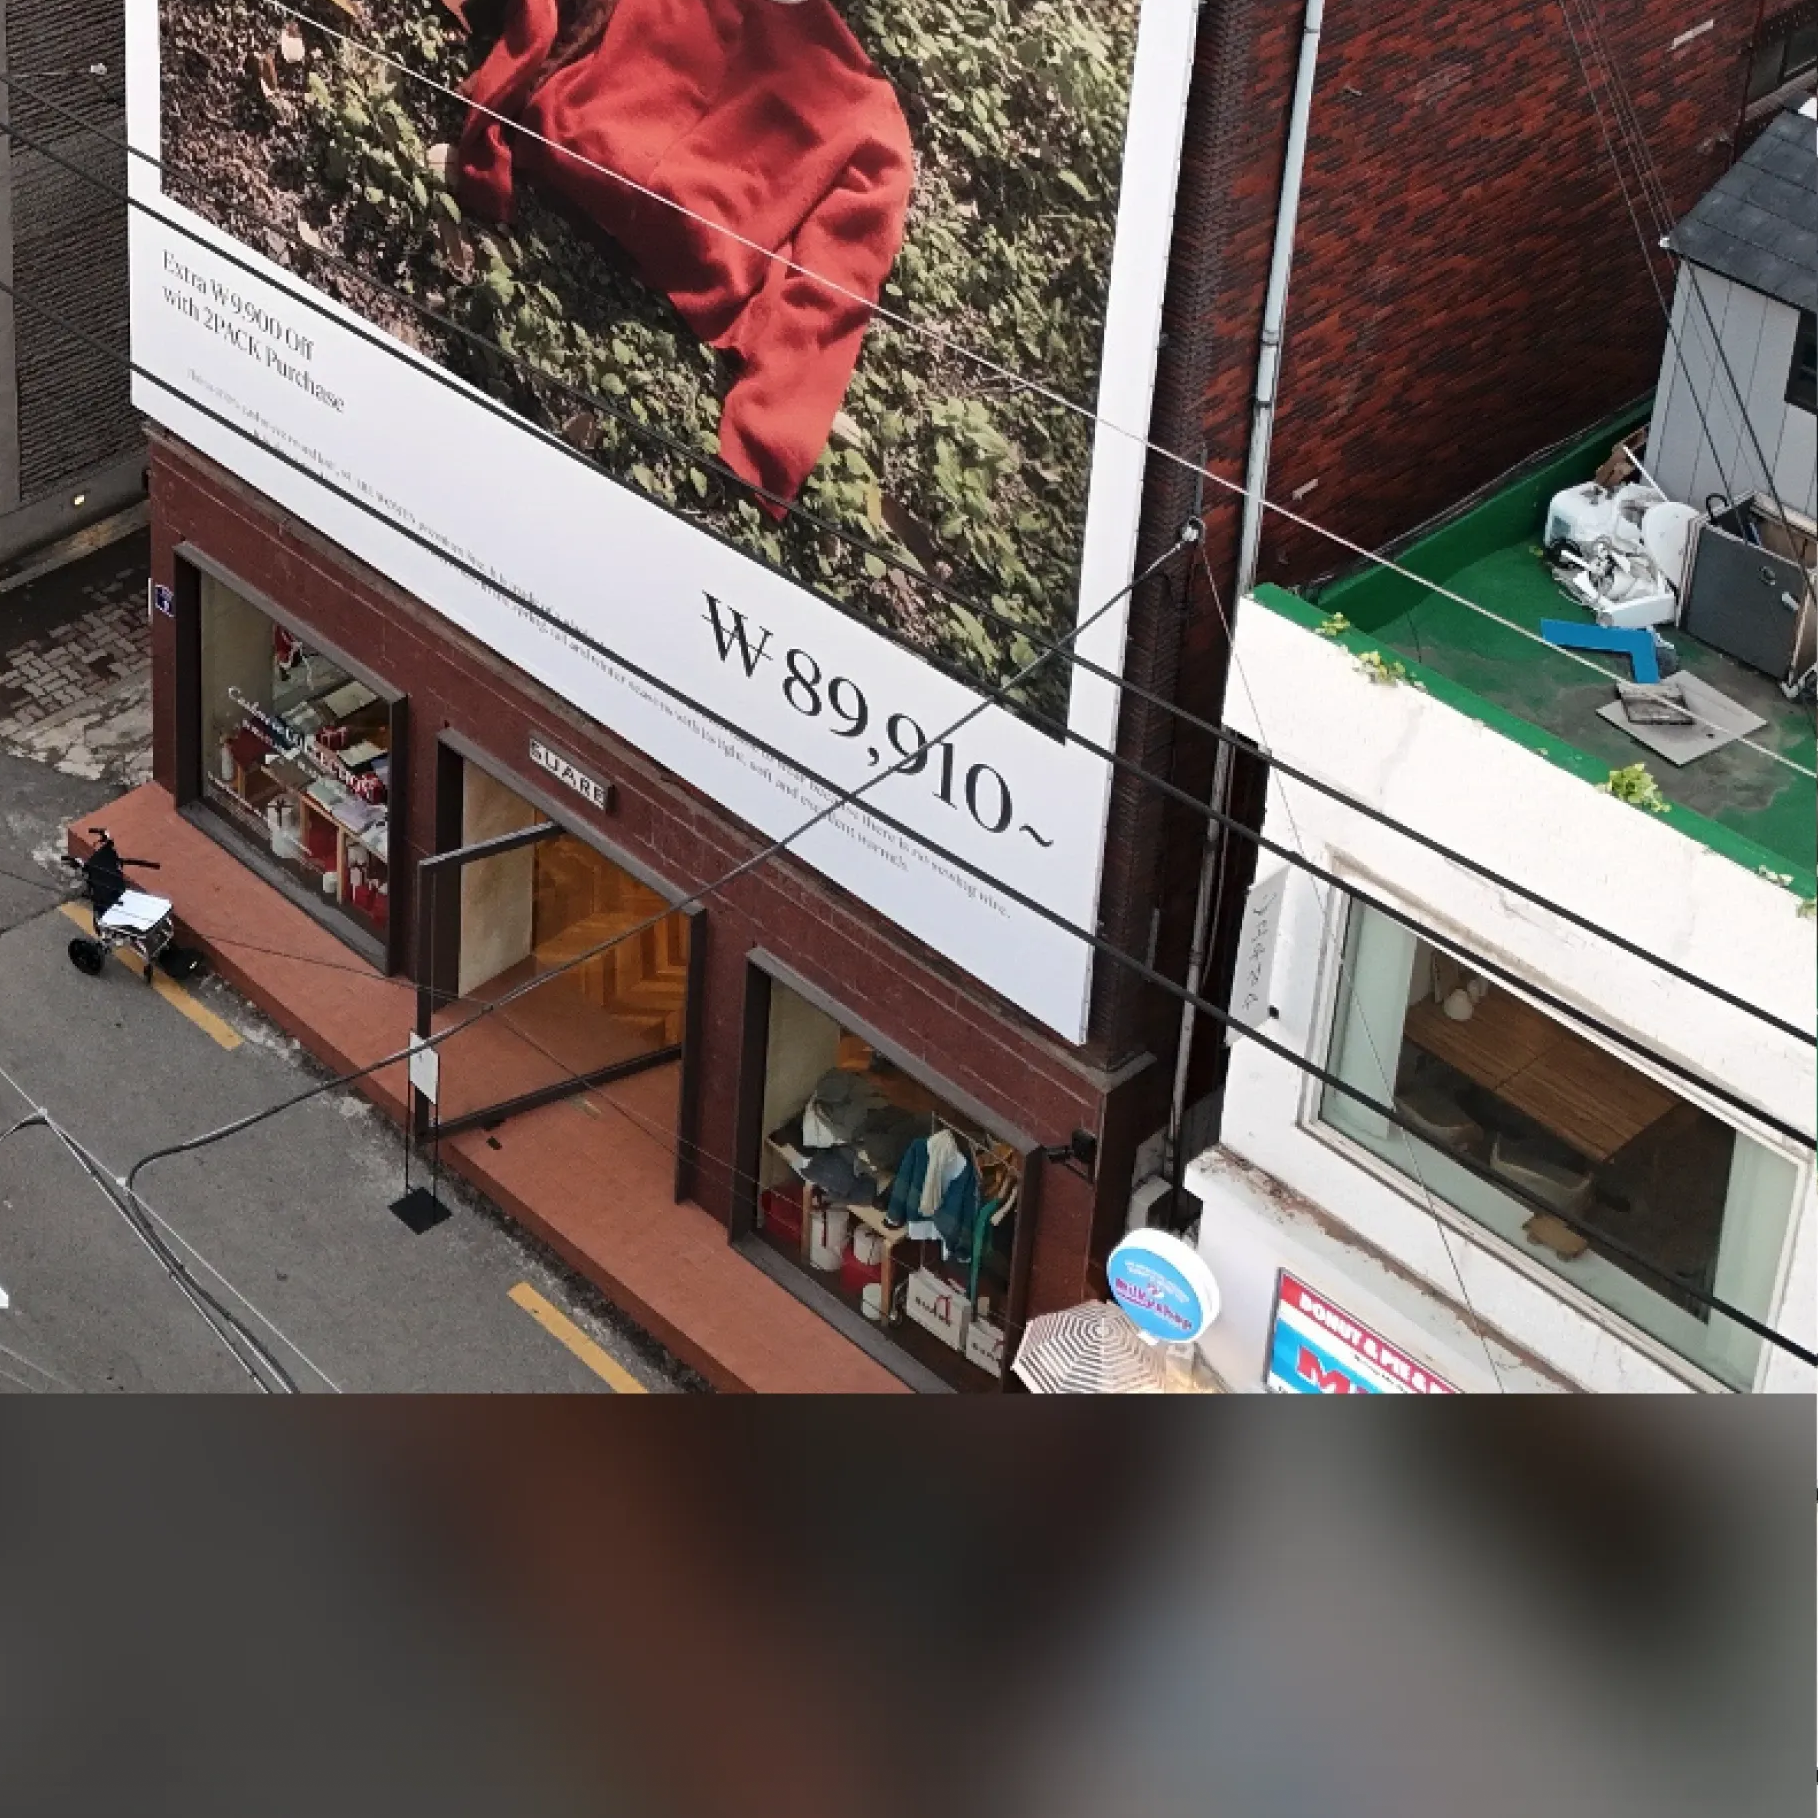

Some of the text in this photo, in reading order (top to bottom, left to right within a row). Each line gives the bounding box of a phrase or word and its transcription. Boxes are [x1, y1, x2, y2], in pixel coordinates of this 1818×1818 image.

[162, 248, 207, 295] Extra
[285, 326, 315, 362] Off
[162, 285, 345, 413] with 2PACK Purchase
[1299, 1291, 1364, 1347] DONUT
[1380, 1347, 1412, 1381] PIE
